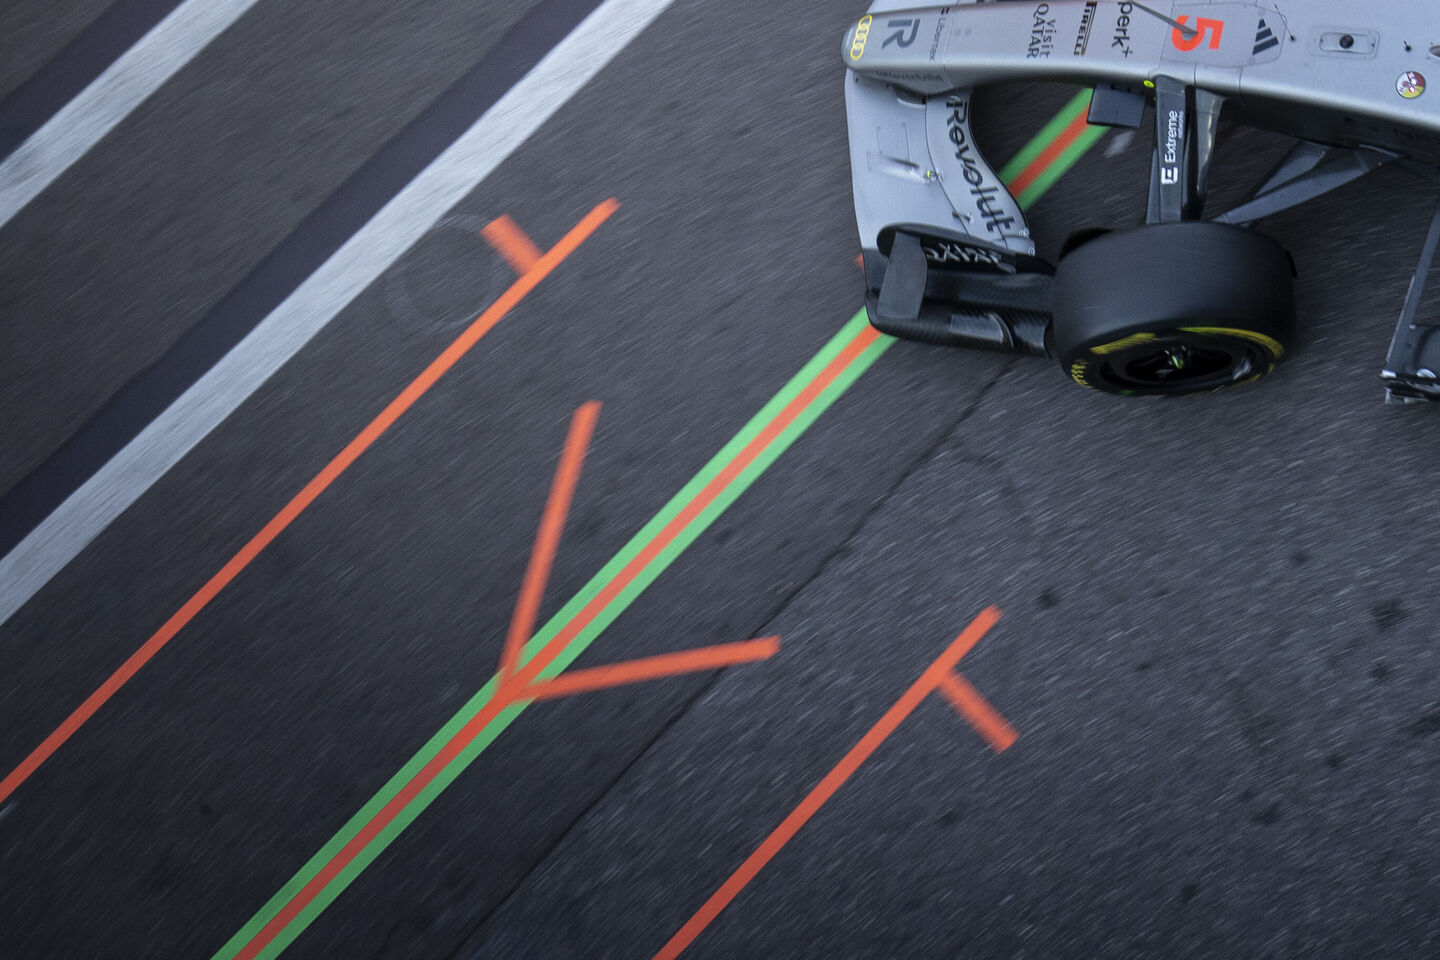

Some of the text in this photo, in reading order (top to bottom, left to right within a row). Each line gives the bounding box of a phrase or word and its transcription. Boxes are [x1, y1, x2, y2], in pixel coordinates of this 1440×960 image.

[1026, 3, 1050, 59] QATAR
[1039, 18, 1057, 58] visit
[1073, 0, 1098, 56] PIRELLI
[1171, 14, 1224, 52] 5
[1164, 110, 1178, 163] Extreme
[946, 98, 1015, 233] Revolut
